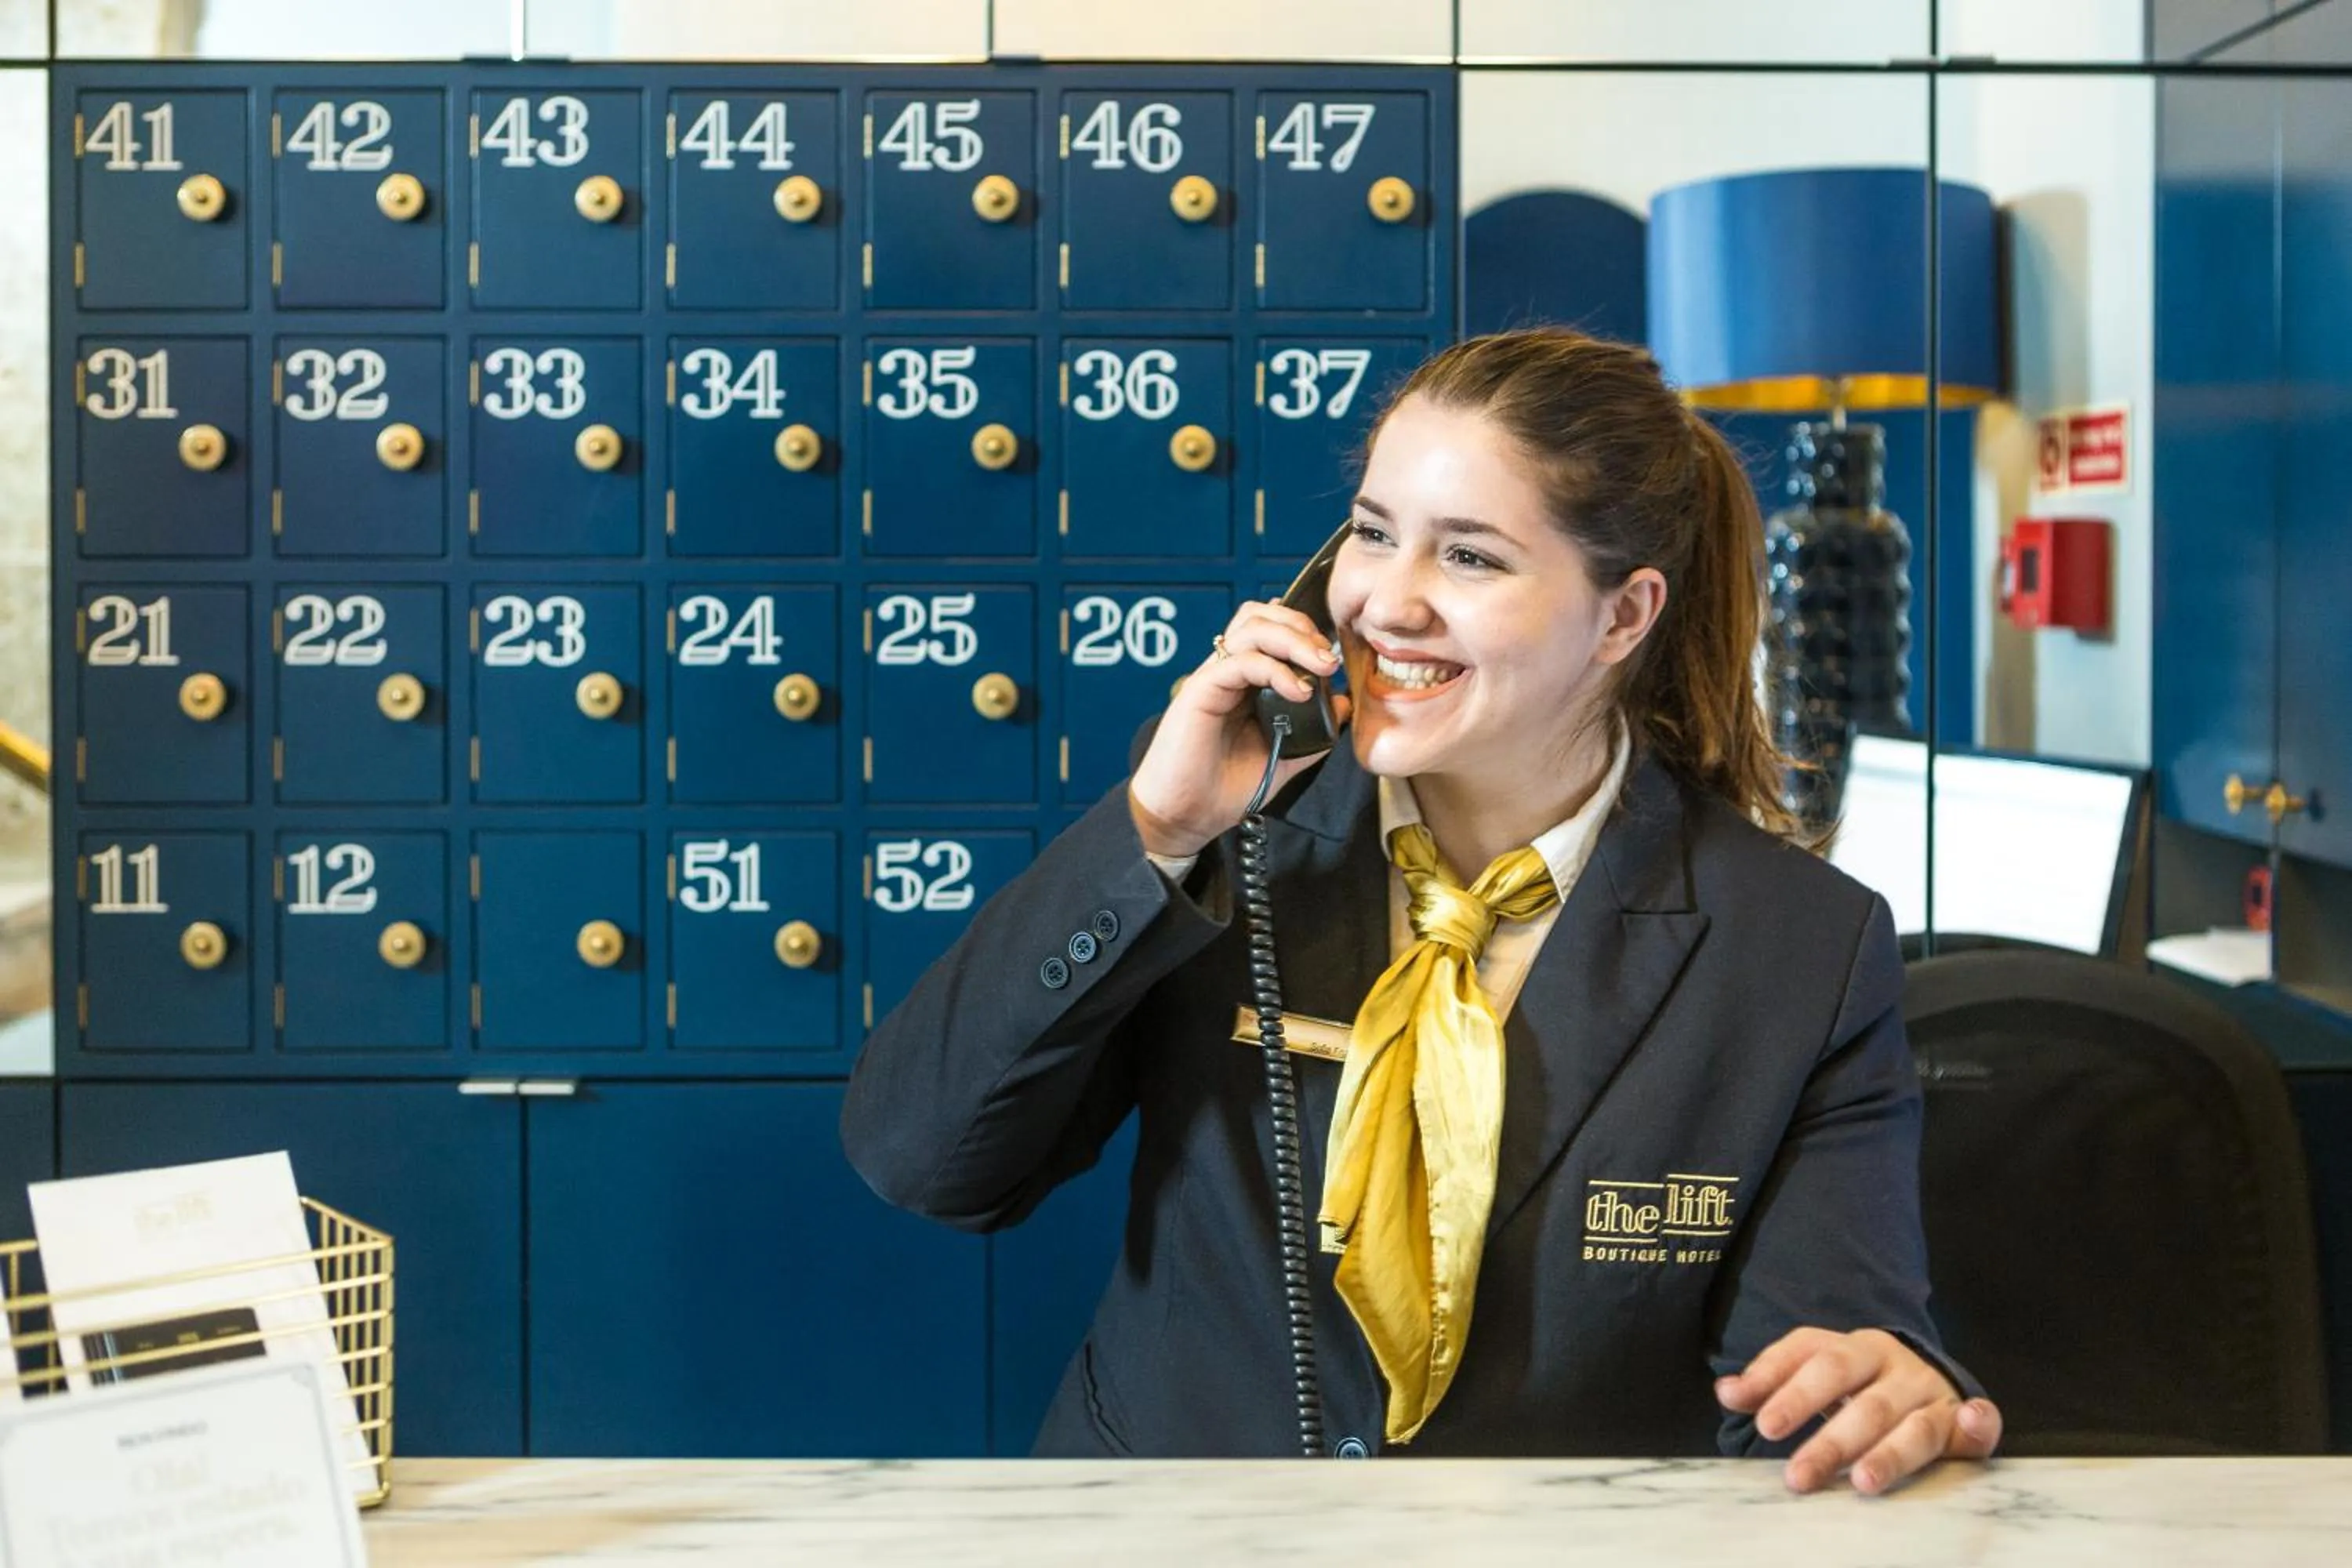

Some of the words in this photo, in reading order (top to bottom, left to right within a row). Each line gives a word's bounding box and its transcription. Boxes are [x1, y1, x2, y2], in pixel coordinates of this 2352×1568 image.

[84, 102, 182, 171] 41
[286, 101, 393, 171] 42
[481, 96, 589, 167] 43
[680, 100, 794, 170] 44
[879, 99, 983, 172] 45
[1072, 100, 1182, 172] 46
[1268, 102, 1375, 172] 47
[85, 348, 178, 419] 31
[285, 349, 389, 420] 32
[484, 348, 586, 419] 33
[681, 348, 785, 419] 34
[878, 346, 978, 419] 35
[1074, 350, 1178, 419] 36
[1270, 350, 1370, 418] 37
[88, 595, 179, 666] 21
[284, 595, 387, 666] 22
[485, 596, 585, 666] 23
[679, 596, 782, 665] 24
[877, 593, 977, 665] 25
[1073, 597, 1178, 666] 26
[92, 844, 167, 913] 11
[289, 844, 377, 913] 12
[680, 840, 768, 912] 51
[874, 840, 974, 911] 52
[1586, 1191, 1661, 1234] the
[1663, 1183, 1736, 1226] lift
[1583, 1246, 1668, 1263] BOUTIQUE
